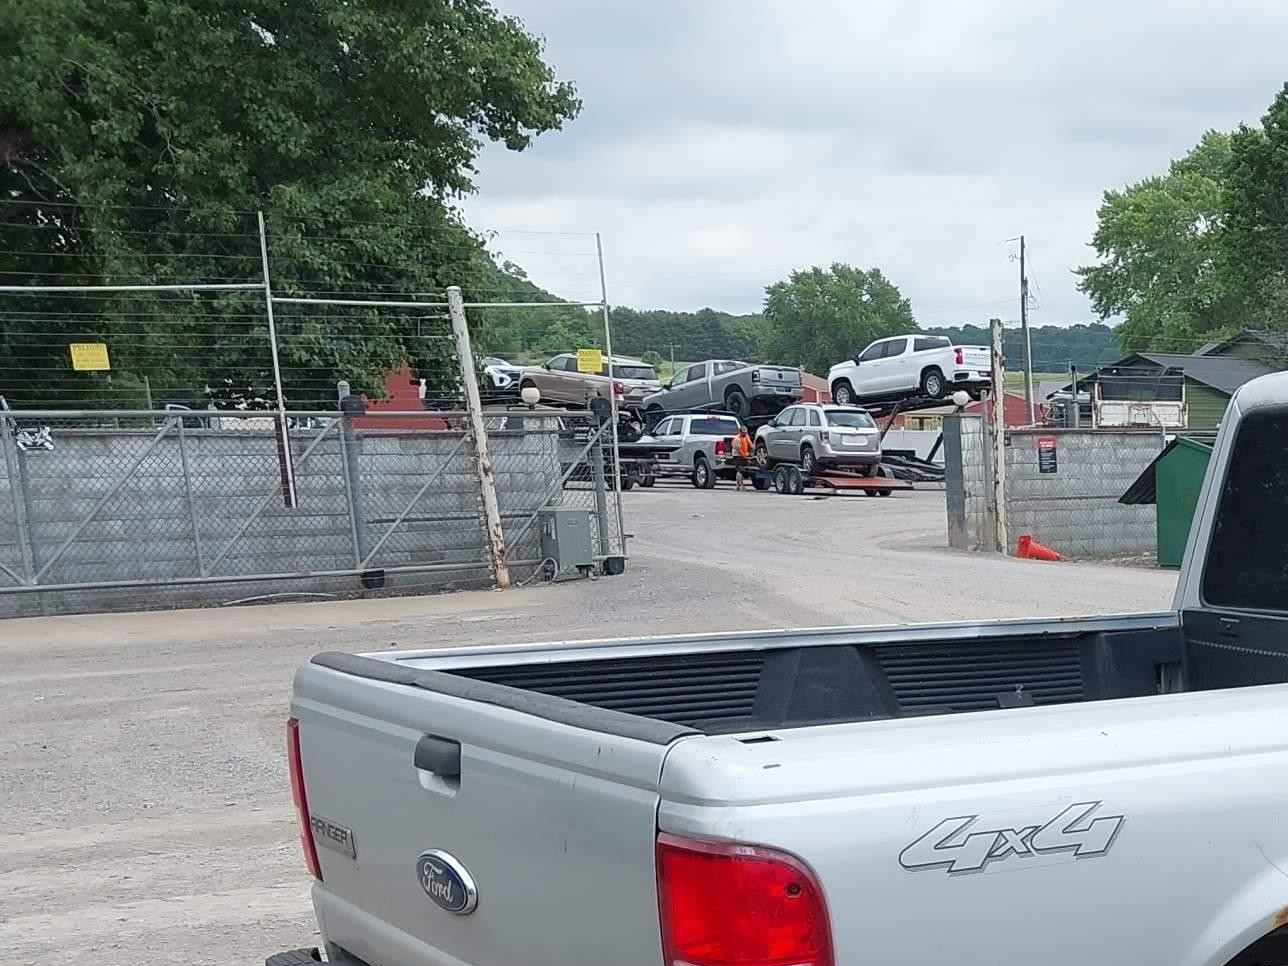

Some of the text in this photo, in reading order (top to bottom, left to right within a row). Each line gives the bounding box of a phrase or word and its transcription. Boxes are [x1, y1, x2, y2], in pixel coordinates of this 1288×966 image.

[311, 816, 349, 847] RANGER
[898, 800, 1127, 877] 4x4
[422, 861, 454, 903] Ford
